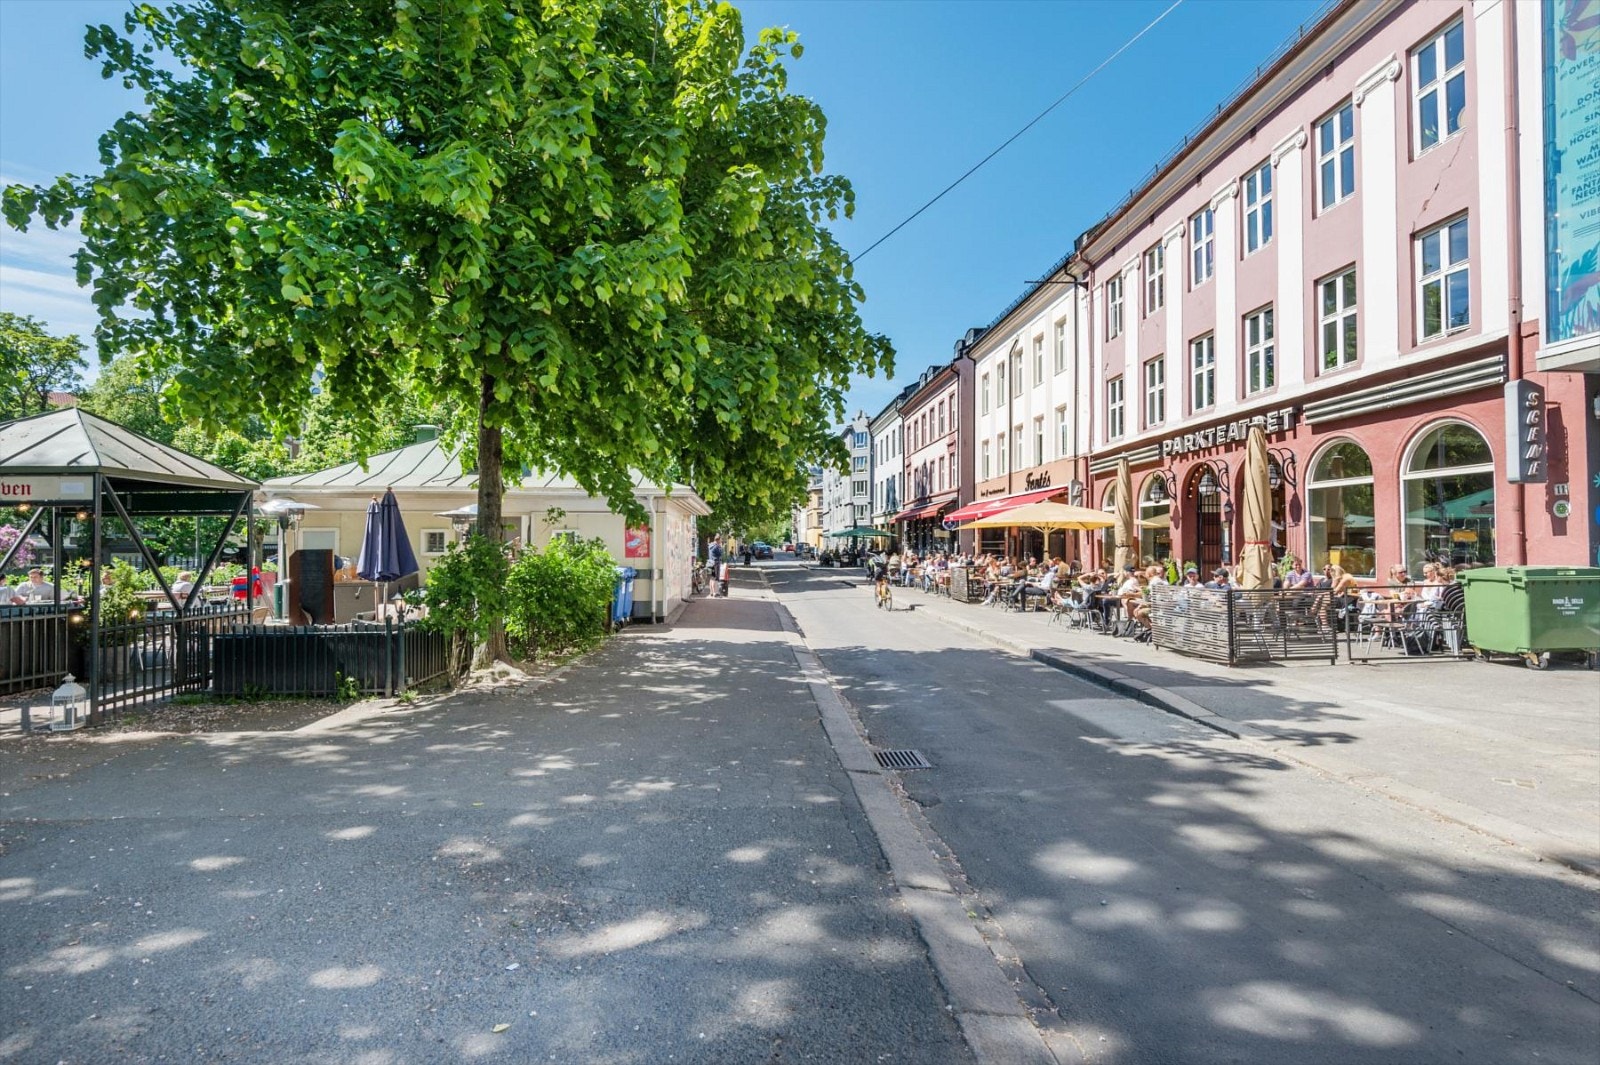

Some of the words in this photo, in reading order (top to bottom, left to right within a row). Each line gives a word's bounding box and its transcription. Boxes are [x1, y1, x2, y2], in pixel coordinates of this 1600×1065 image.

[1568, 55, 1595, 75] OVER
[1162, 406, 1294, 457] PARKTEATET
[1525, 391, 1542, 476] SCENE
